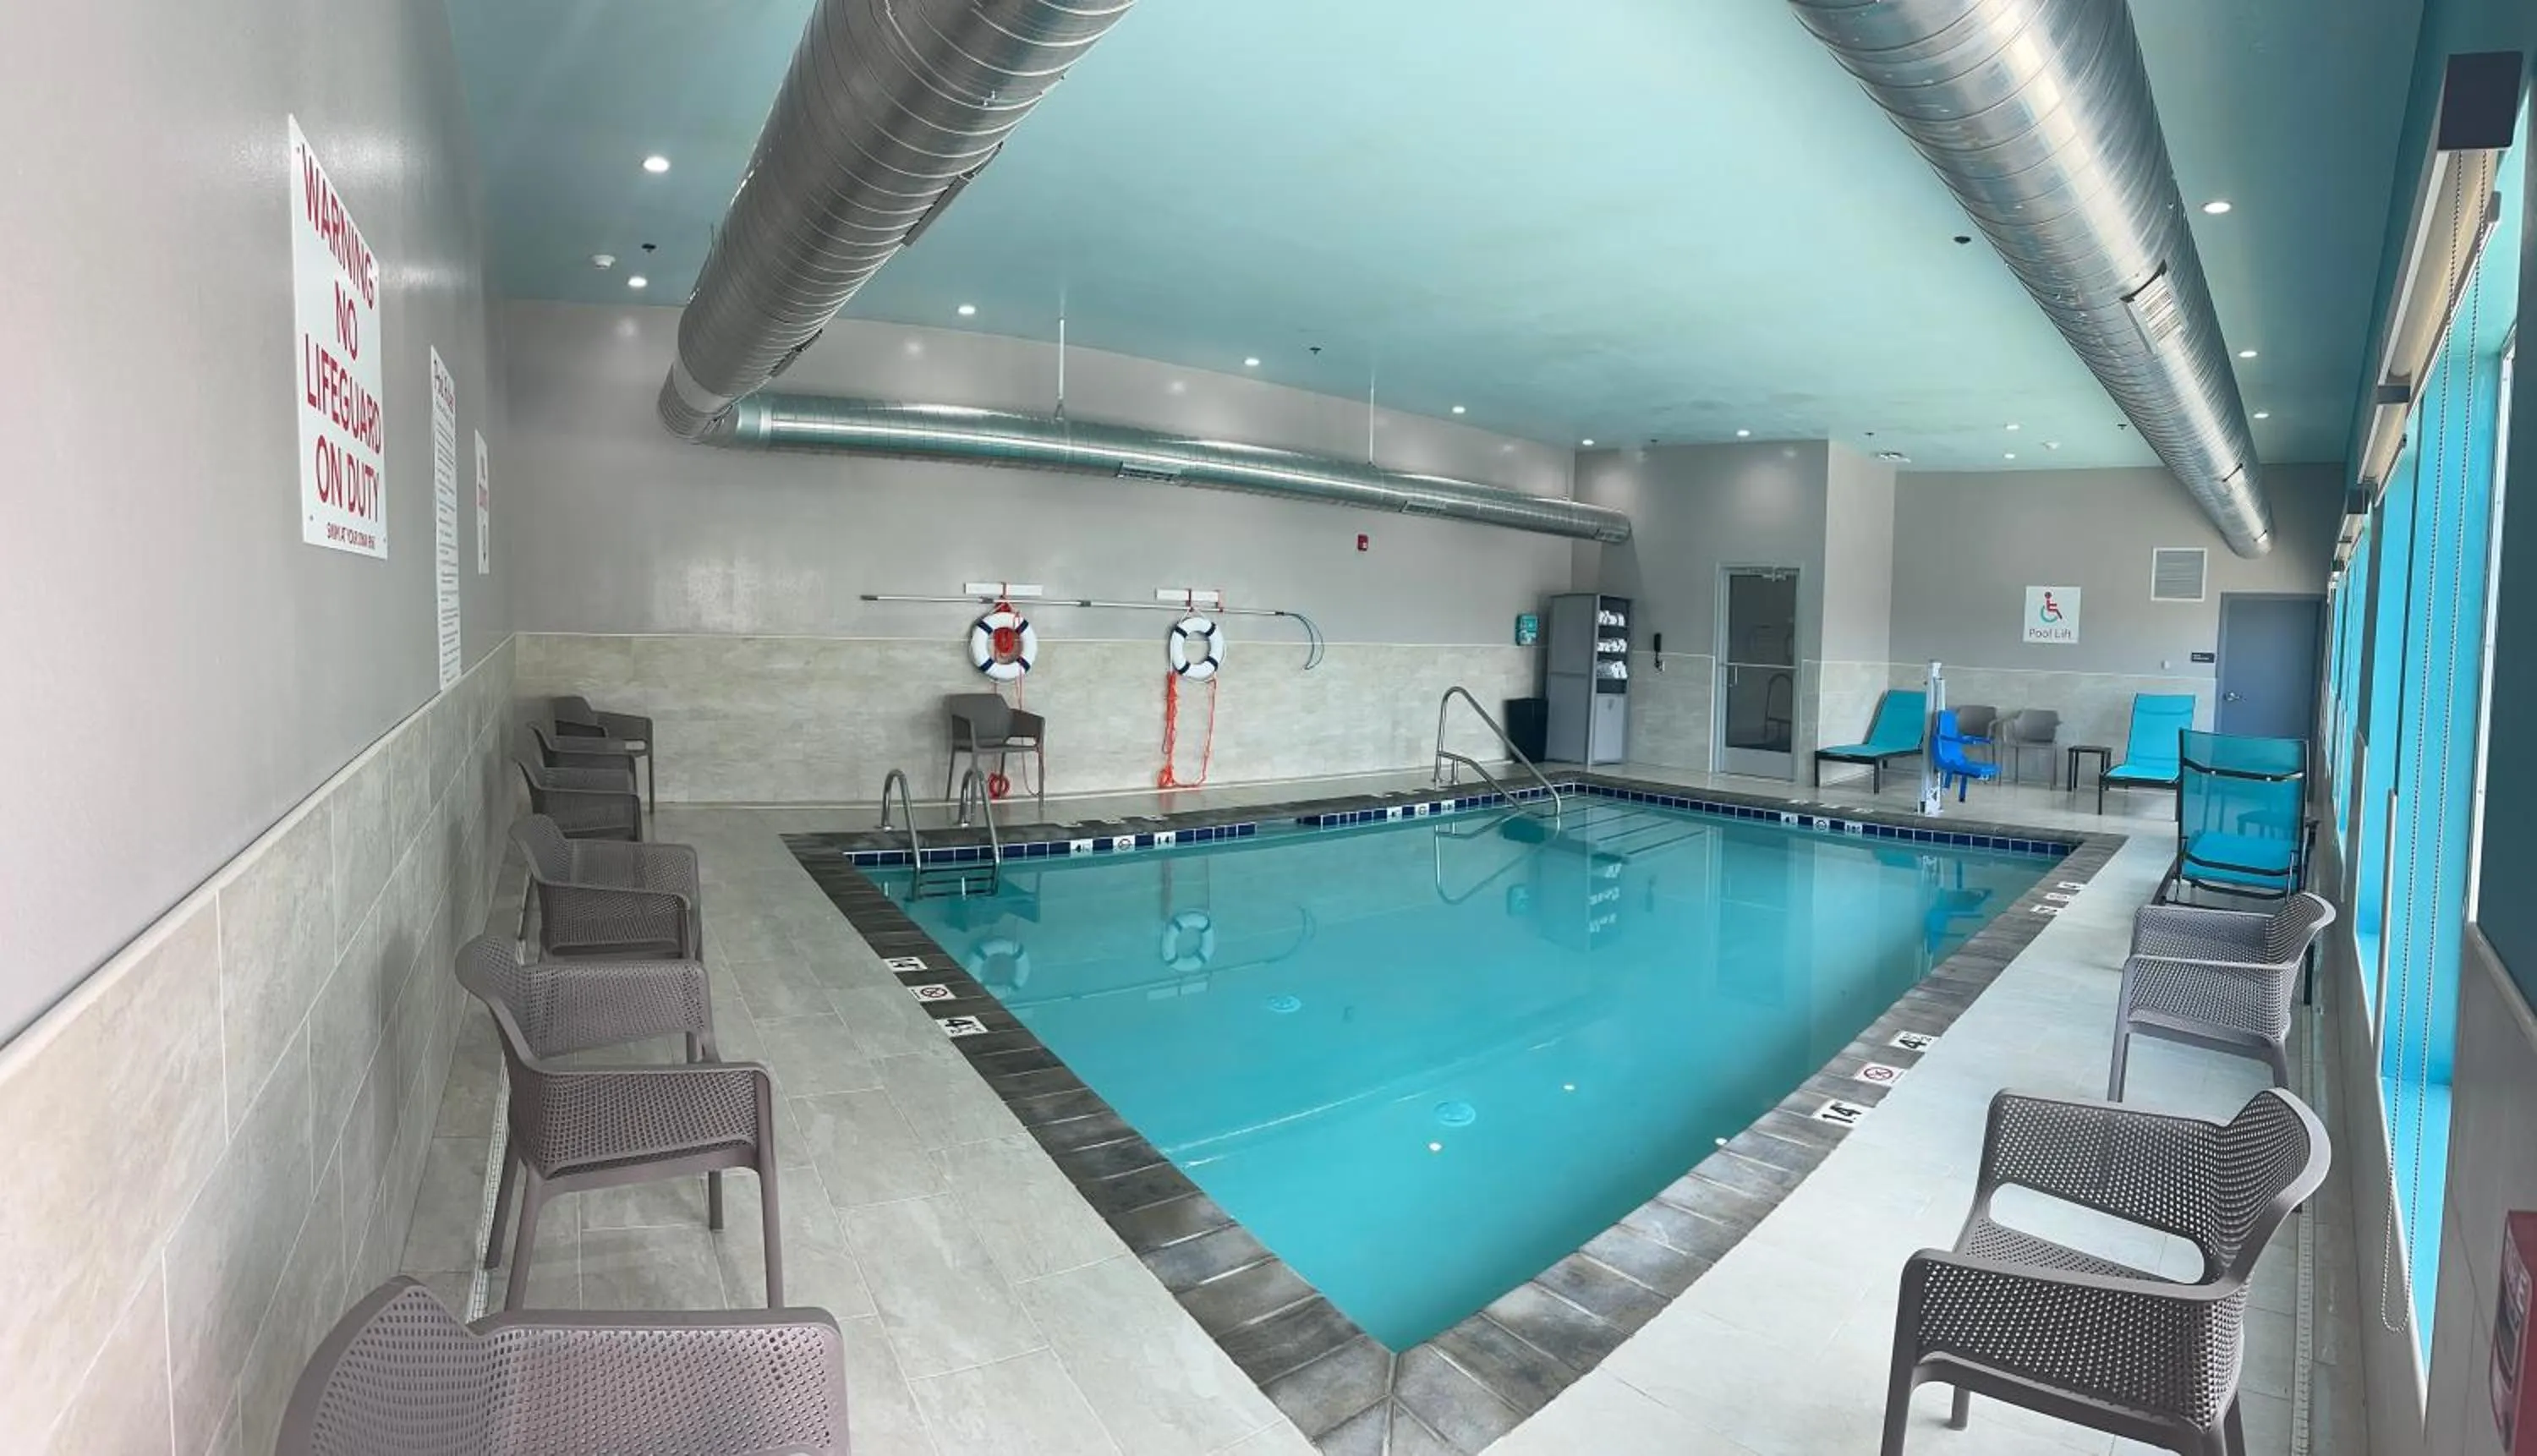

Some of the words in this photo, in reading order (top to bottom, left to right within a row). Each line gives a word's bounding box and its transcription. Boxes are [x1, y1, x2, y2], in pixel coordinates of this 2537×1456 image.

[302, 142, 375, 310] WARNING
[335, 279, 357, 361] NO
[305, 332, 381, 455] LIFEGUARD
[315, 435, 342, 509] ON
[346, 452, 380, 523] DUTY
[2030, 628, 2052, 638] Pool
[2055, 628, 2071, 638] Lift
